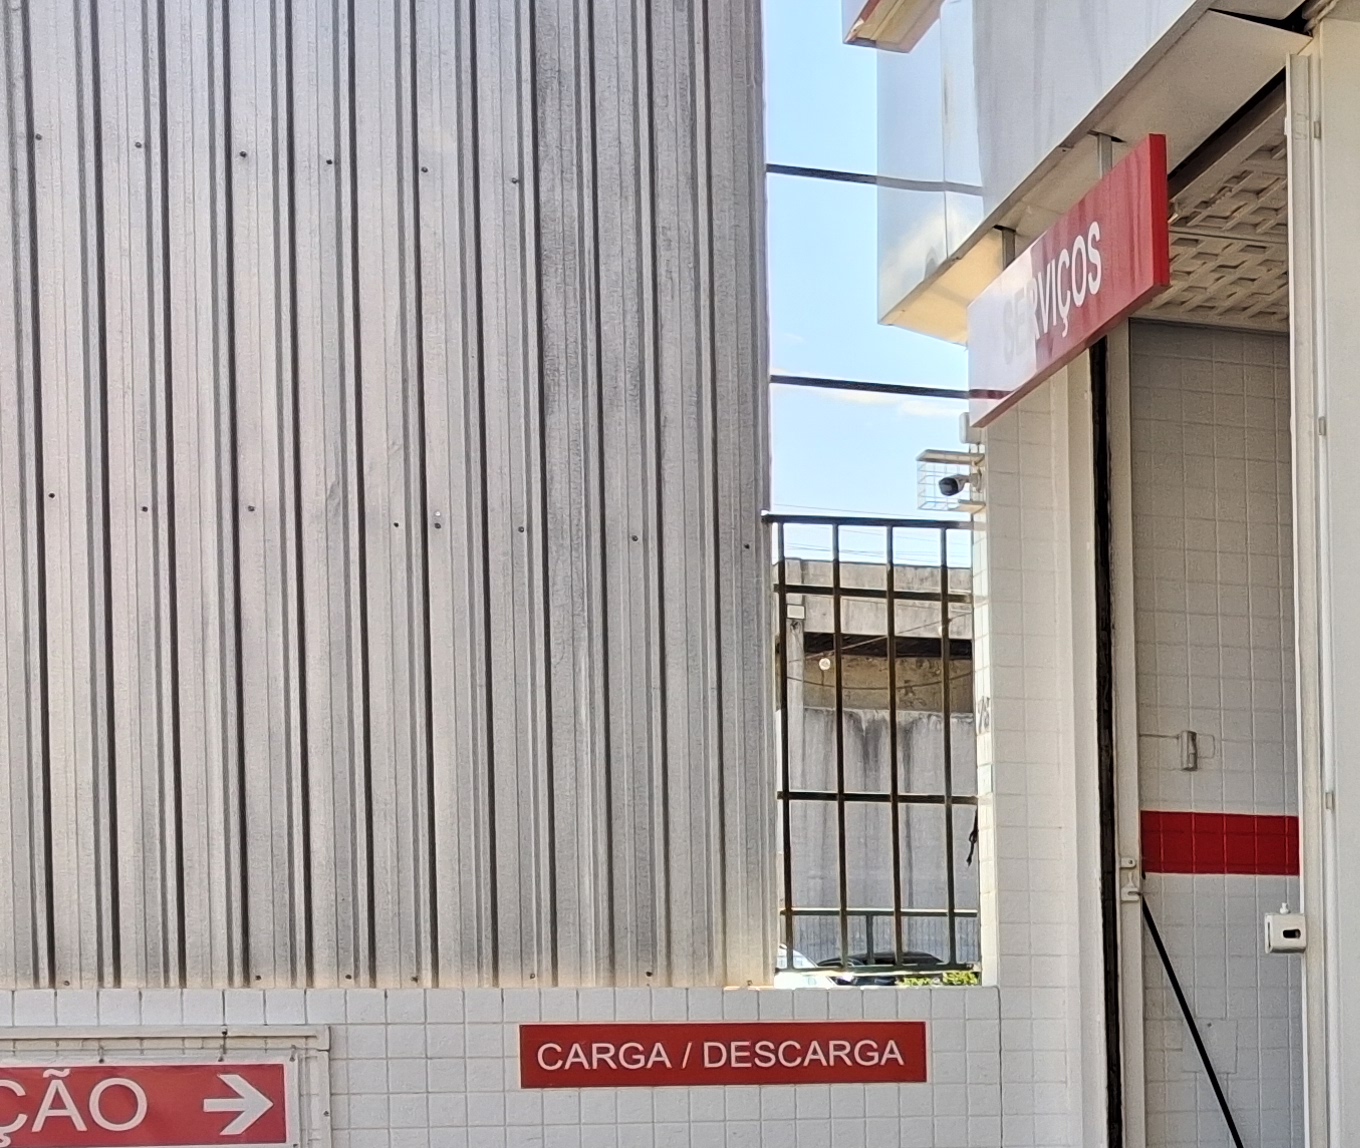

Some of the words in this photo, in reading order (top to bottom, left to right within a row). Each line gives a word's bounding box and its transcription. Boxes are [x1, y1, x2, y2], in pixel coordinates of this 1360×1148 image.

[537, 1042, 671, 1071] CARGA
[682, 1042, 692, 1069] /
[703, 1039, 904, 1069] DESCARGA
